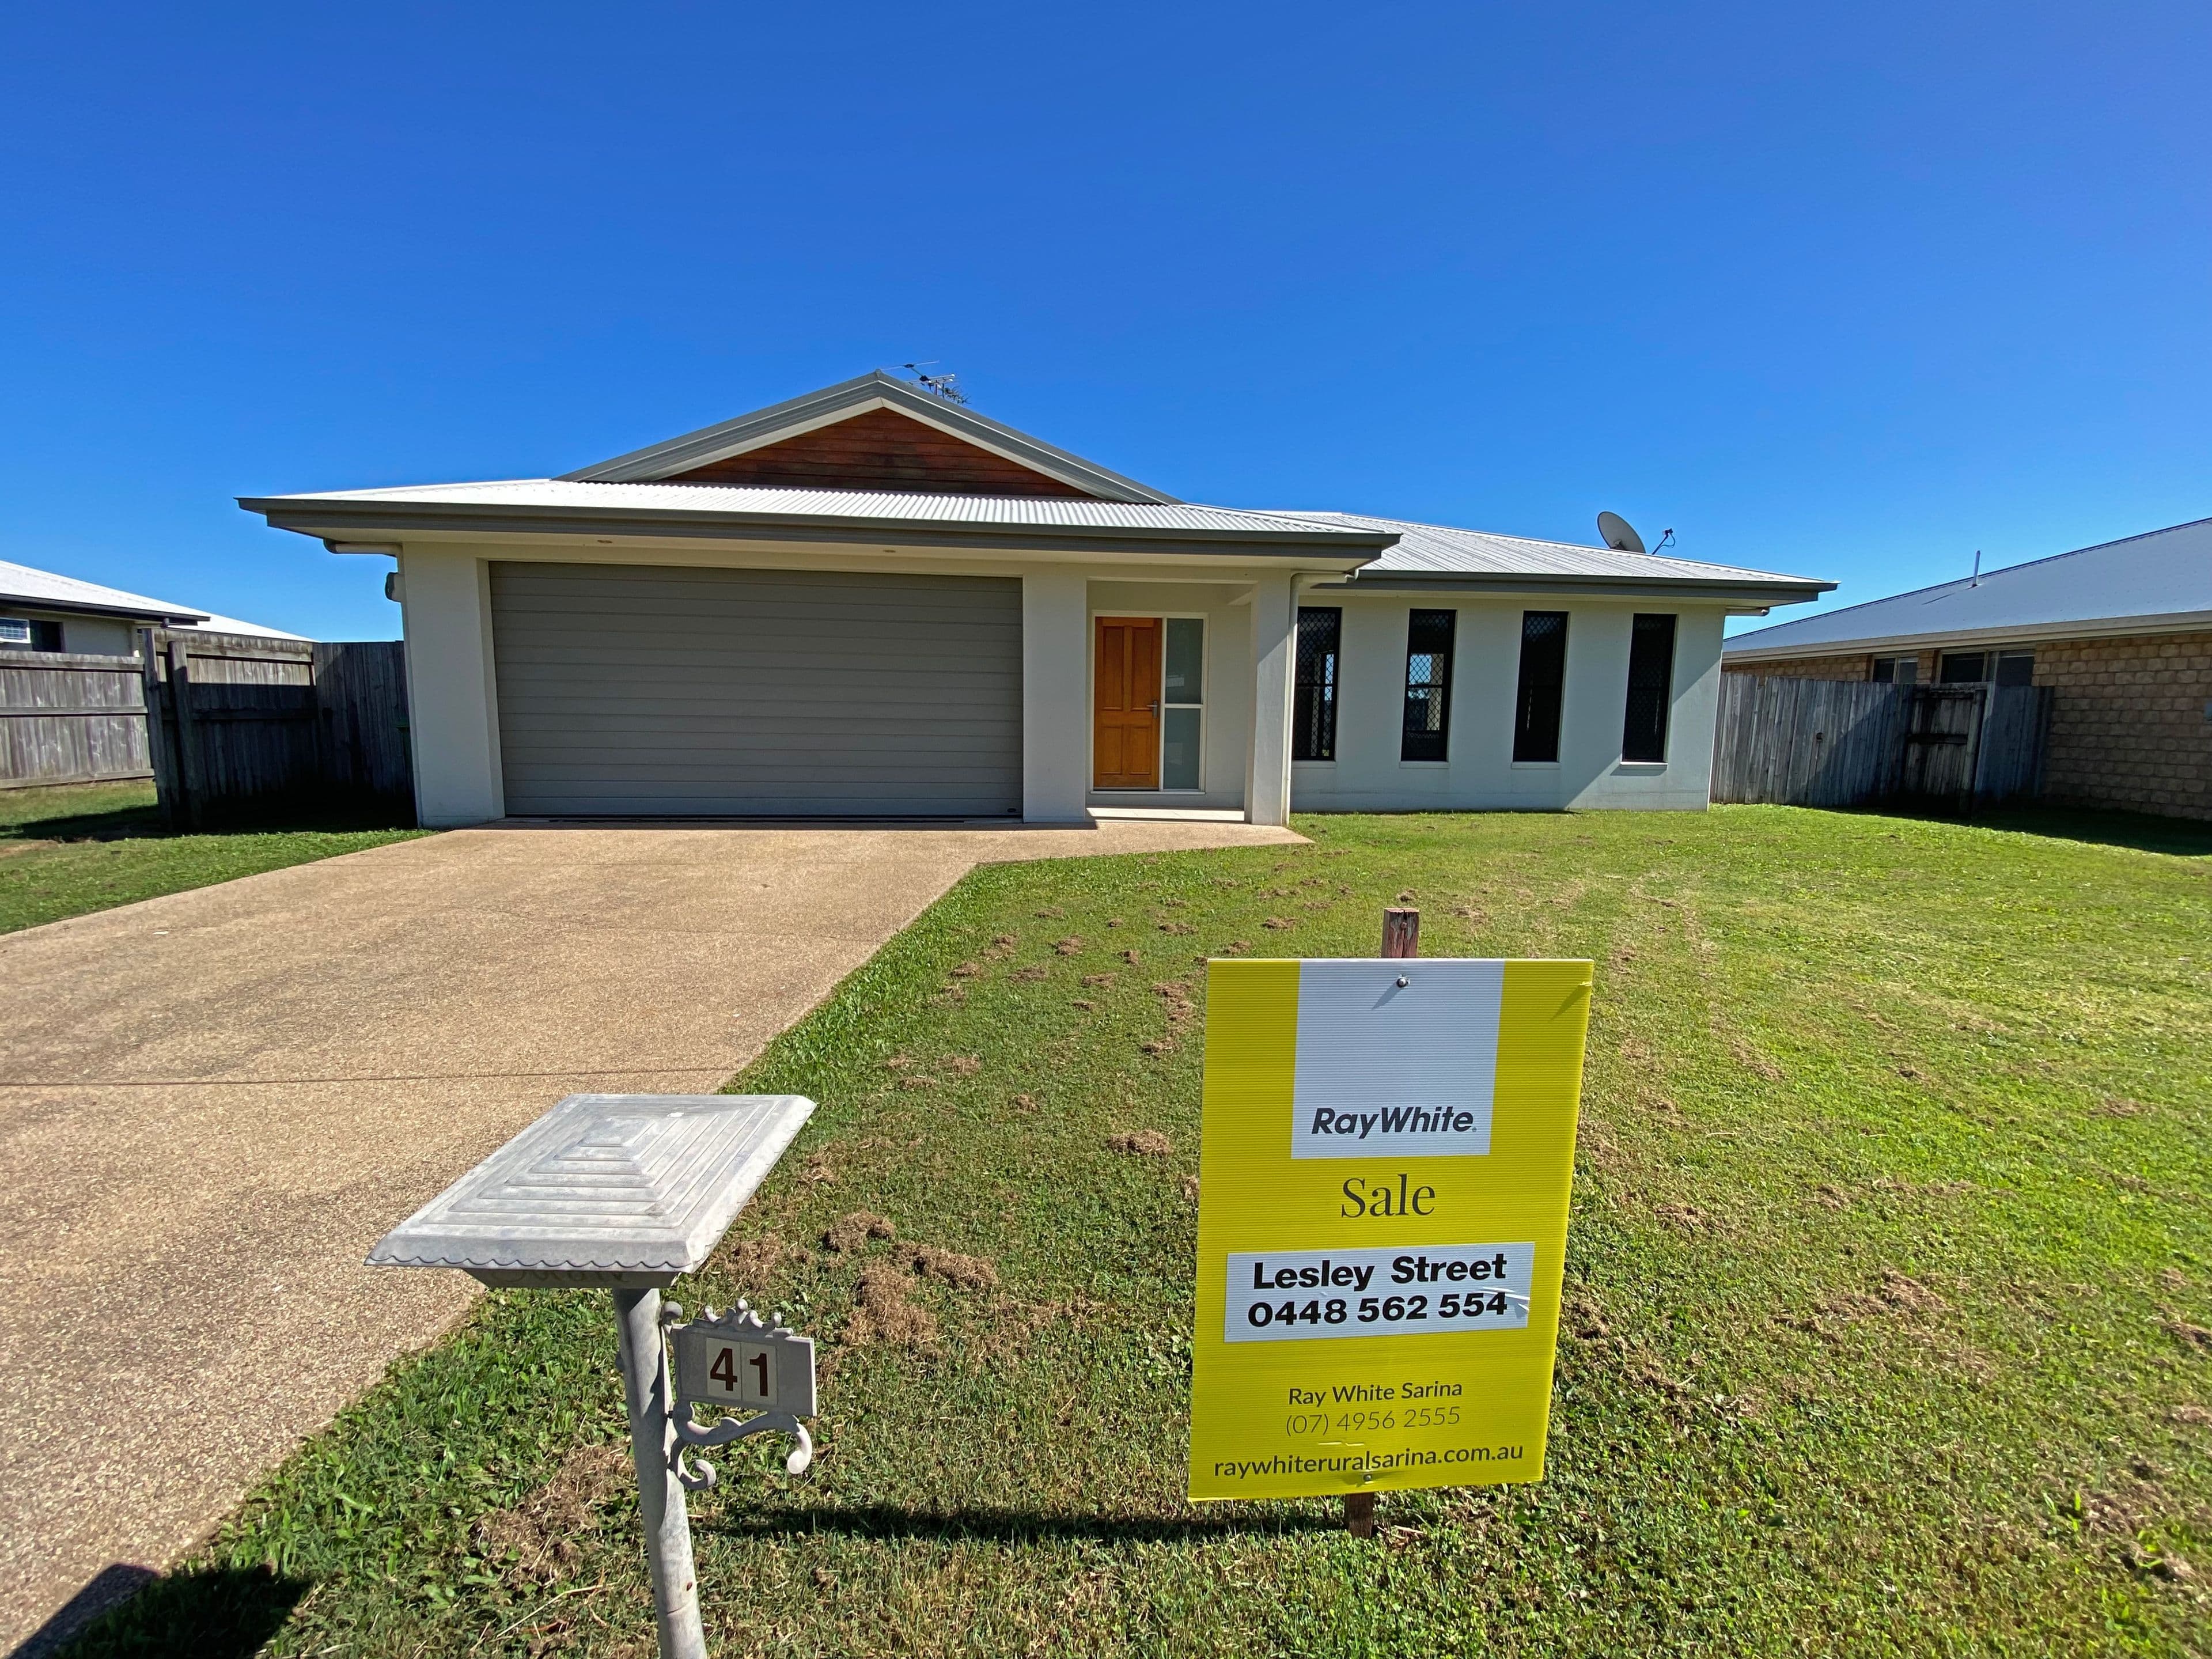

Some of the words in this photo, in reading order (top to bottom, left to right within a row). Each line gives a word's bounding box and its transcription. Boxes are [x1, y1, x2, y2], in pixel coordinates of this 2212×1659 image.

[1341, 1172, 1436, 1218] Sale
[1253, 1259, 1375, 1291] Lesley
[1391, 1253, 1508, 1285] Street
[1248, 1298, 1347, 1328] 0448
[1357, 1295, 1429, 1323] 562
[1437, 1291, 1508, 1319] 554
[710, 1347, 769, 1397] 41
[1288, 1387, 1327, 1407] Ray
[1332, 1384, 1395, 1403] White
[1401, 1380, 1463, 1400] Sarina
[1286, 1414, 1330, 1437] (07)
[1336, 1411, 1395, 1431] 4956
[1404, 1406, 1461, 1428] 2555
[1214, 1445, 1524, 1479] raywhiteruralsarina.com.au
